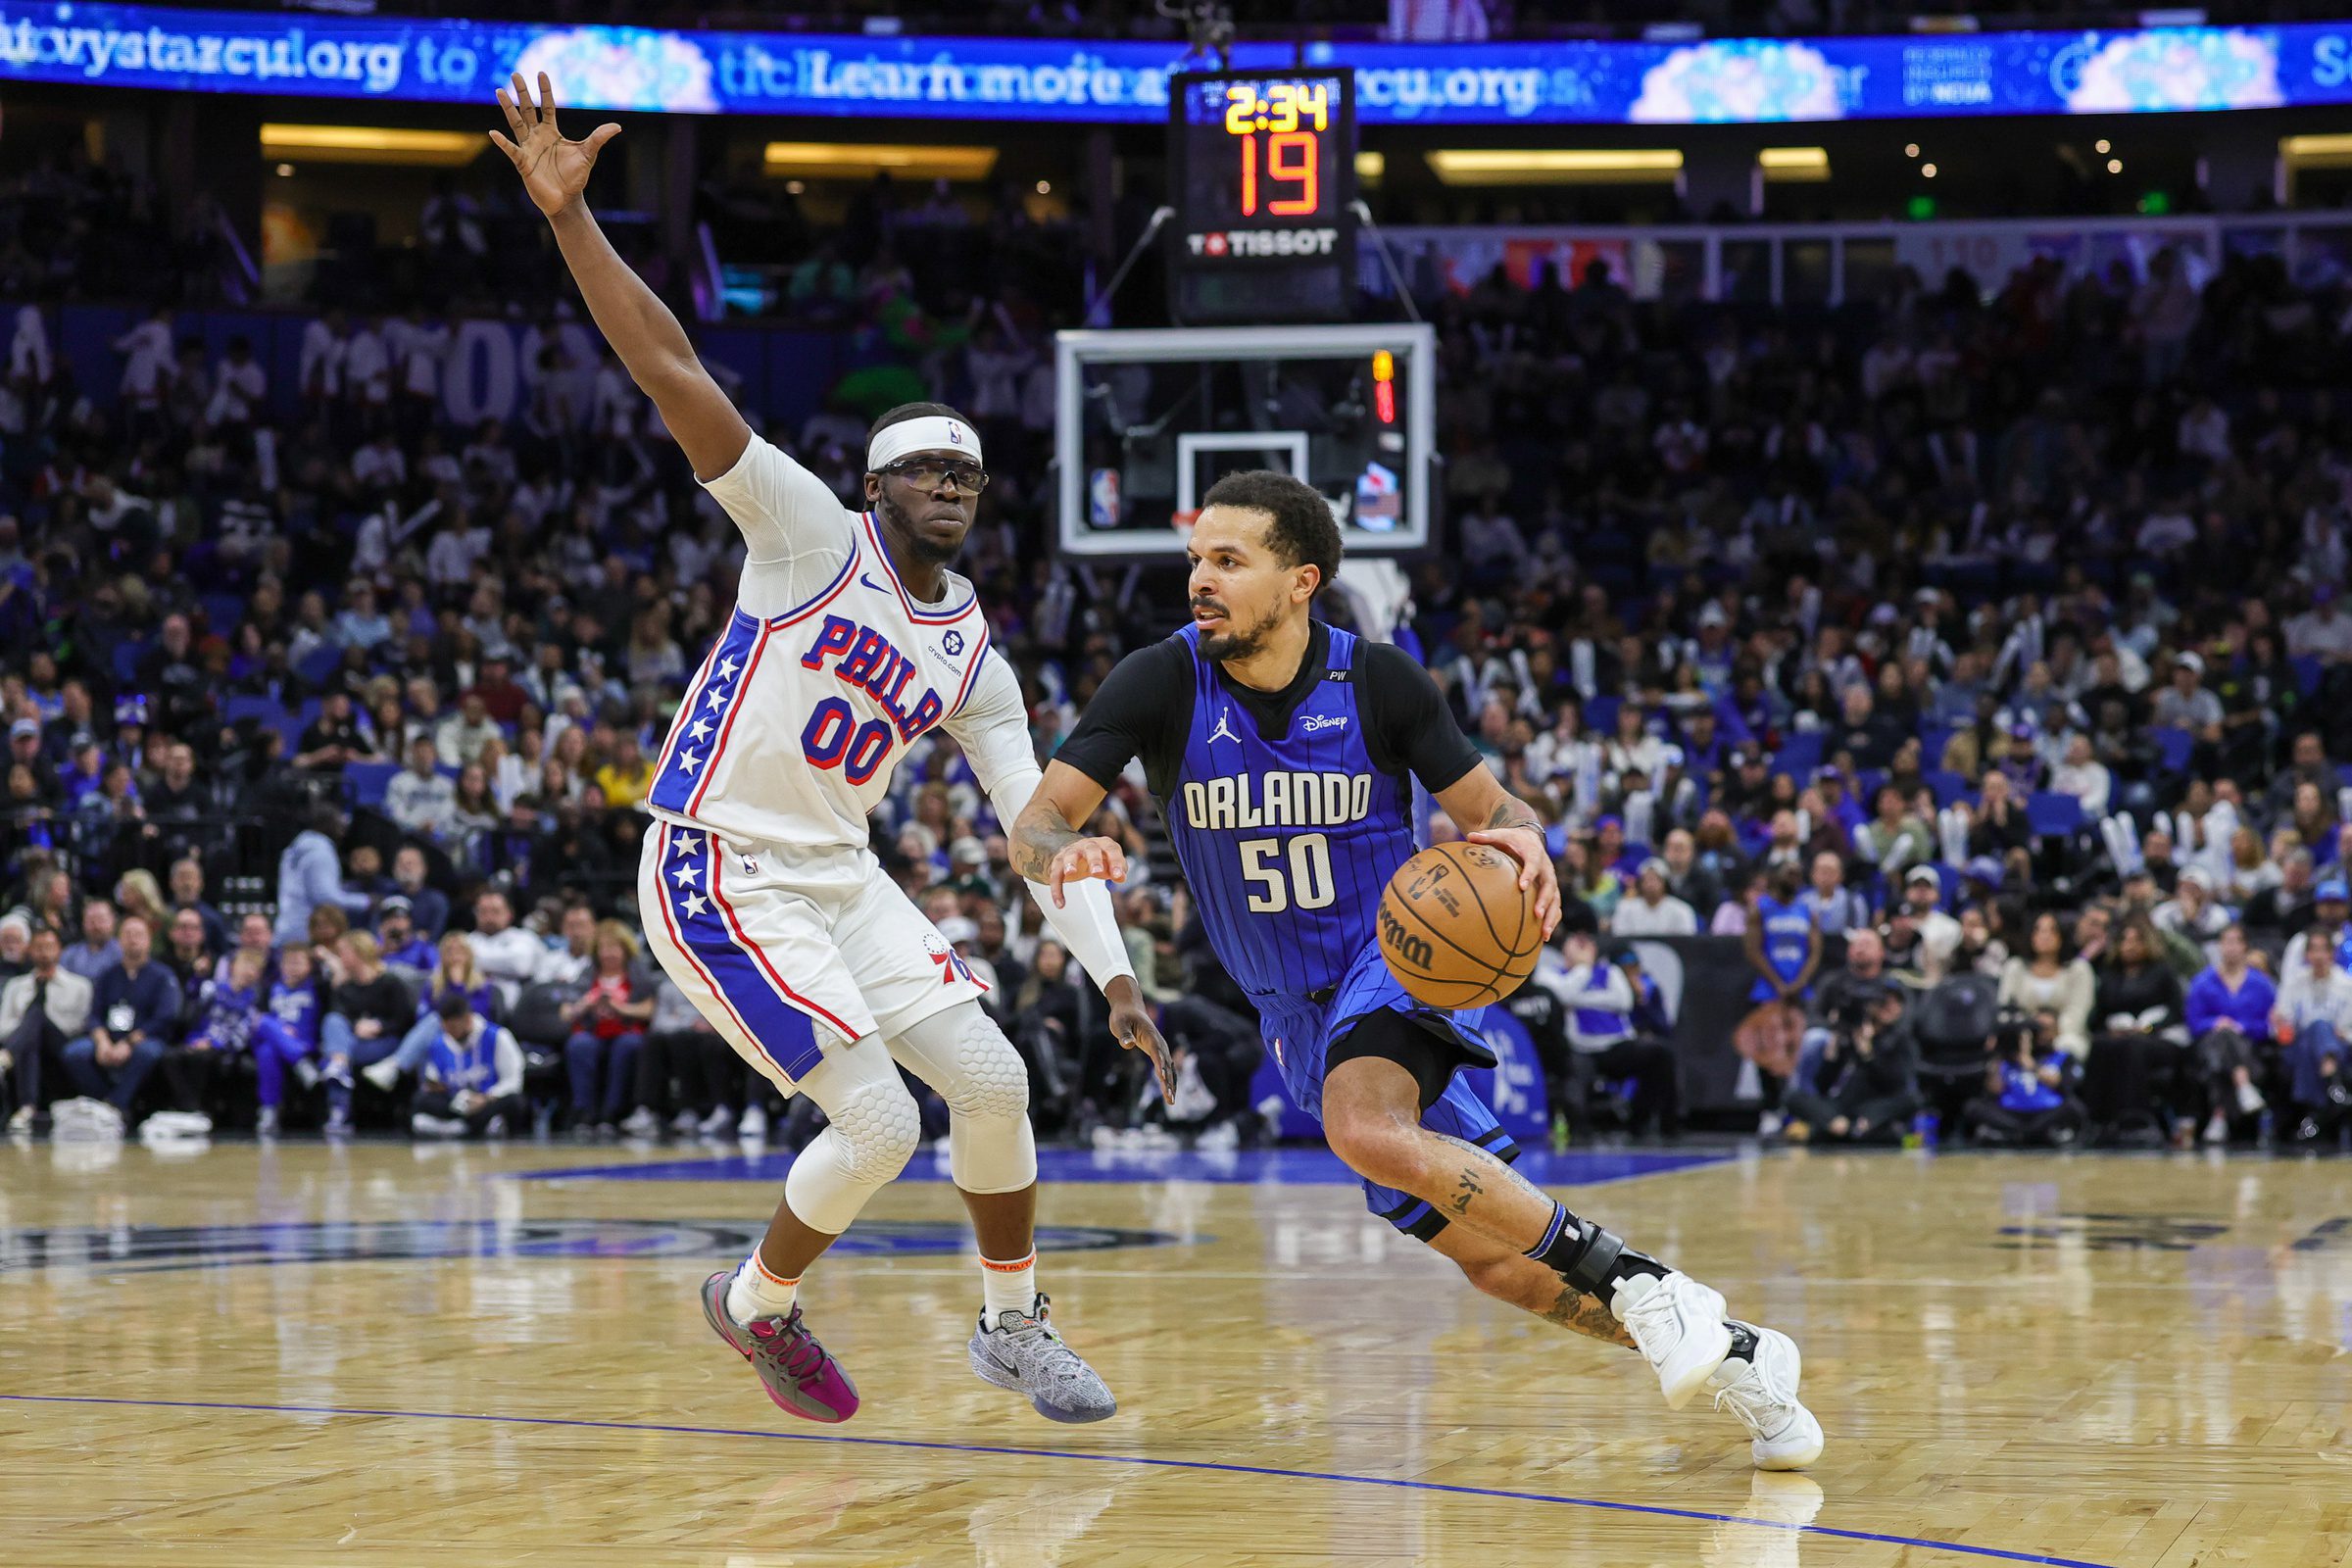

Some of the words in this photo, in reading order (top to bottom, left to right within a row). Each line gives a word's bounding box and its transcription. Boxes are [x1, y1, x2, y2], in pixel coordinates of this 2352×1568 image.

[1226, 84, 1328, 134] 2:34
[1242, 131, 1318, 217] 19
[1227, 228, 1339, 257] TISSOT
[927, 645, 962, 677] crypto.com
[1329, 670, 1347, 681] PW
[800, 696, 894, 786] 00
[1183, 770, 1372, 830] ORLANDO
[1239, 832, 1337, 913] 50
